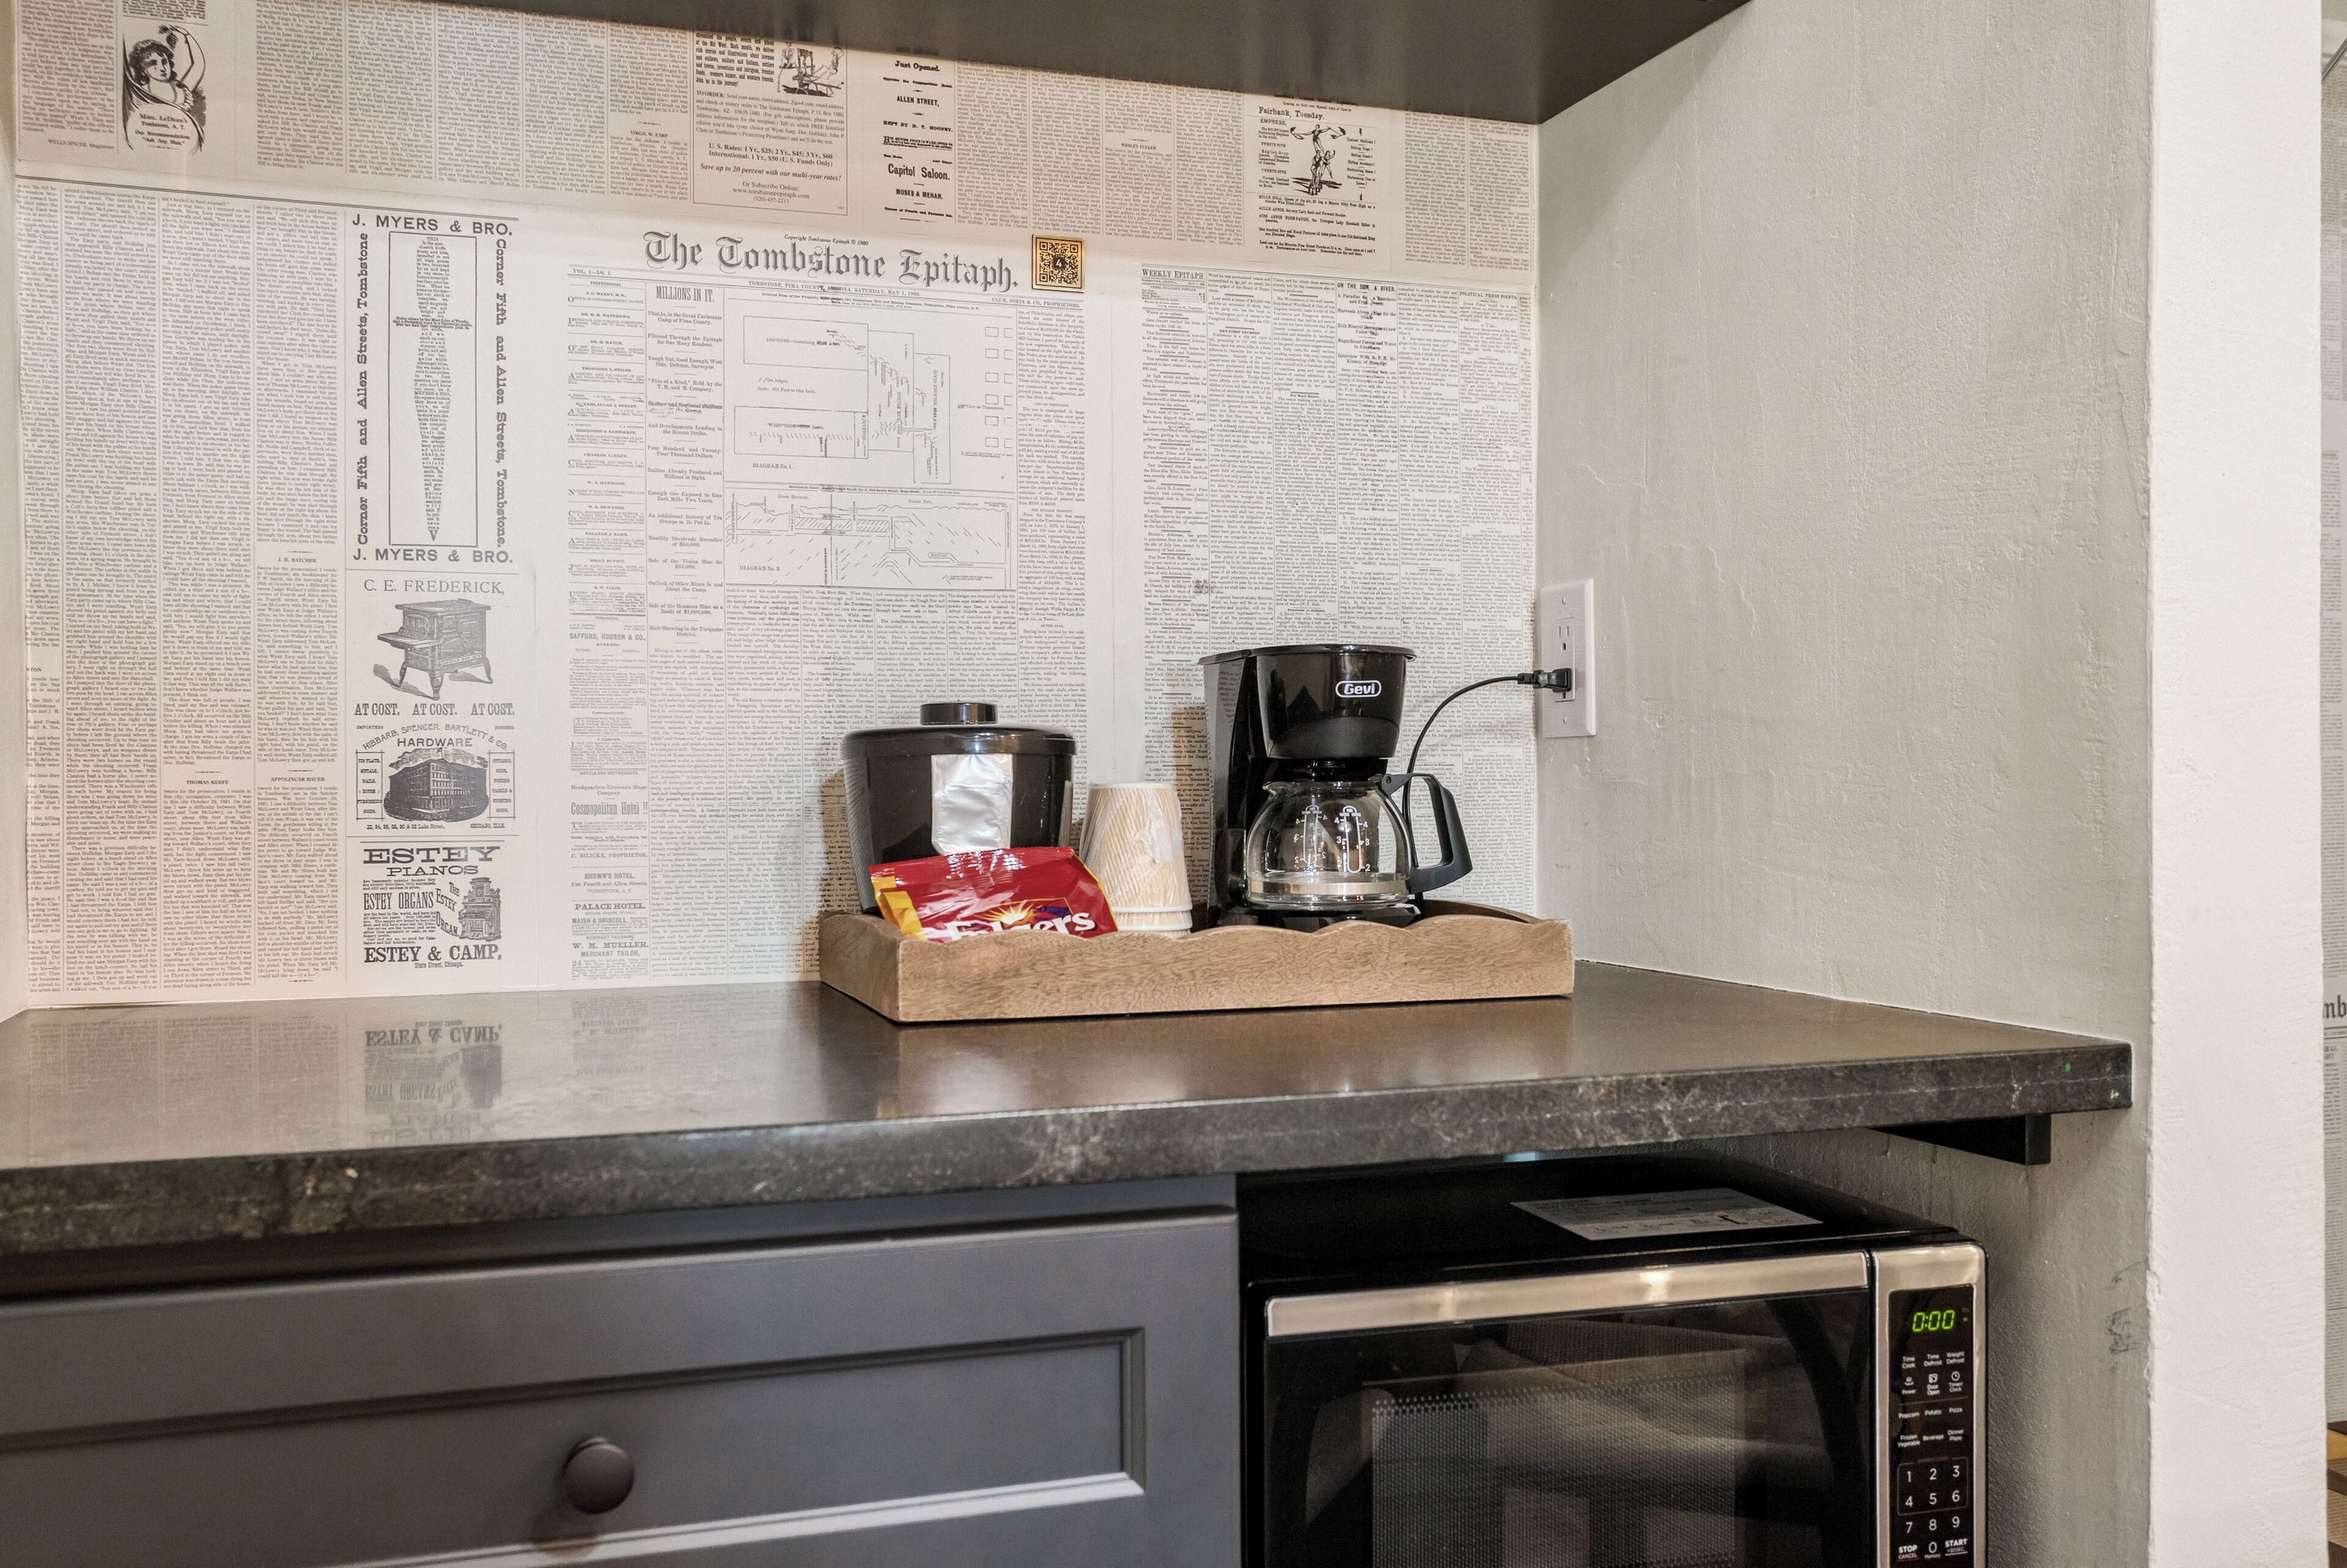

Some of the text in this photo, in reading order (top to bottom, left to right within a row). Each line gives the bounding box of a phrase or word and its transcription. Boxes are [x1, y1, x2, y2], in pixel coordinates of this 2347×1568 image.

[914, 63, 940, 72] Opened.
[917, 98, 939, 107] STREET,
[1259, 107, 1324, 120] Fairbank, Tuesday.
[792, 172, 823, 180] multi-year
[888, 164, 950, 181] Capitol Saloon.
[922, 191, 943, 200] MEHAN.
[353, 214, 512, 236] J. MYERS & BRO.
[643, 232, 1018, 293] The Tombstone Epitaph.
[1056, 259, 1063, 268] 4
[1142, 269, 1205, 280] WEEKLY EPITAPH.
[656, 286, 714, 302] MILLIONS IN IT.
[357, 233, 369, 545] Corner Fifth and Allen Streets, Tombstone
[496, 239, 507, 548] Corner Fifth and Allen Streets, Tombstone.
[353, 549, 513, 563] J. MYERS & BRO.
[364, 580, 504, 595] C. E. FREDERICK,
[1344, 683, 1376, 695] Gevi
[354, 703, 515, 716] AT COST. AT COST. AT COST.
[363, 730, 399, 750] HIBBARD,
[445, 724, 489, 739] BARTLETT
[397, 738, 473, 747] HARDWARE
[571, 802, 617, 816] Cosmopolitan
[622, 802, 639, 815] Hotel
[364, 846, 501, 864] ESTEY
[387, 865, 479, 876] PIANOS
[449, 882, 460, 897] THE
[364, 892, 434, 910] ESTEY ORGANS
[436, 888, 457, 912] ESTEY
[364, 944, 502, 963] ESTEY & CAMP,
[1912, 1310, 1955, 1332] 0:00
[1907, 1471, 1911, 1483] 1
[1930, 1468, 1937, 1481] 2
[1953, 1465, 1960, 1478] 3
[1905, 1496, 1913, 1508] 4
[1930, 1493, 1937, 1505] 5
[1952, 1490, 1960, 1502] 6
[1906, 1522, 1913, 1534] 7
[1930, 1519, 1937, 1531] 8
[1952, 1517, 1960, 1528] 9
[1899, 1545, 1918, 1553] STOP
[1929, 1542, 1937, 1553] 0
[1945, 1538, 1968, 1548] START
